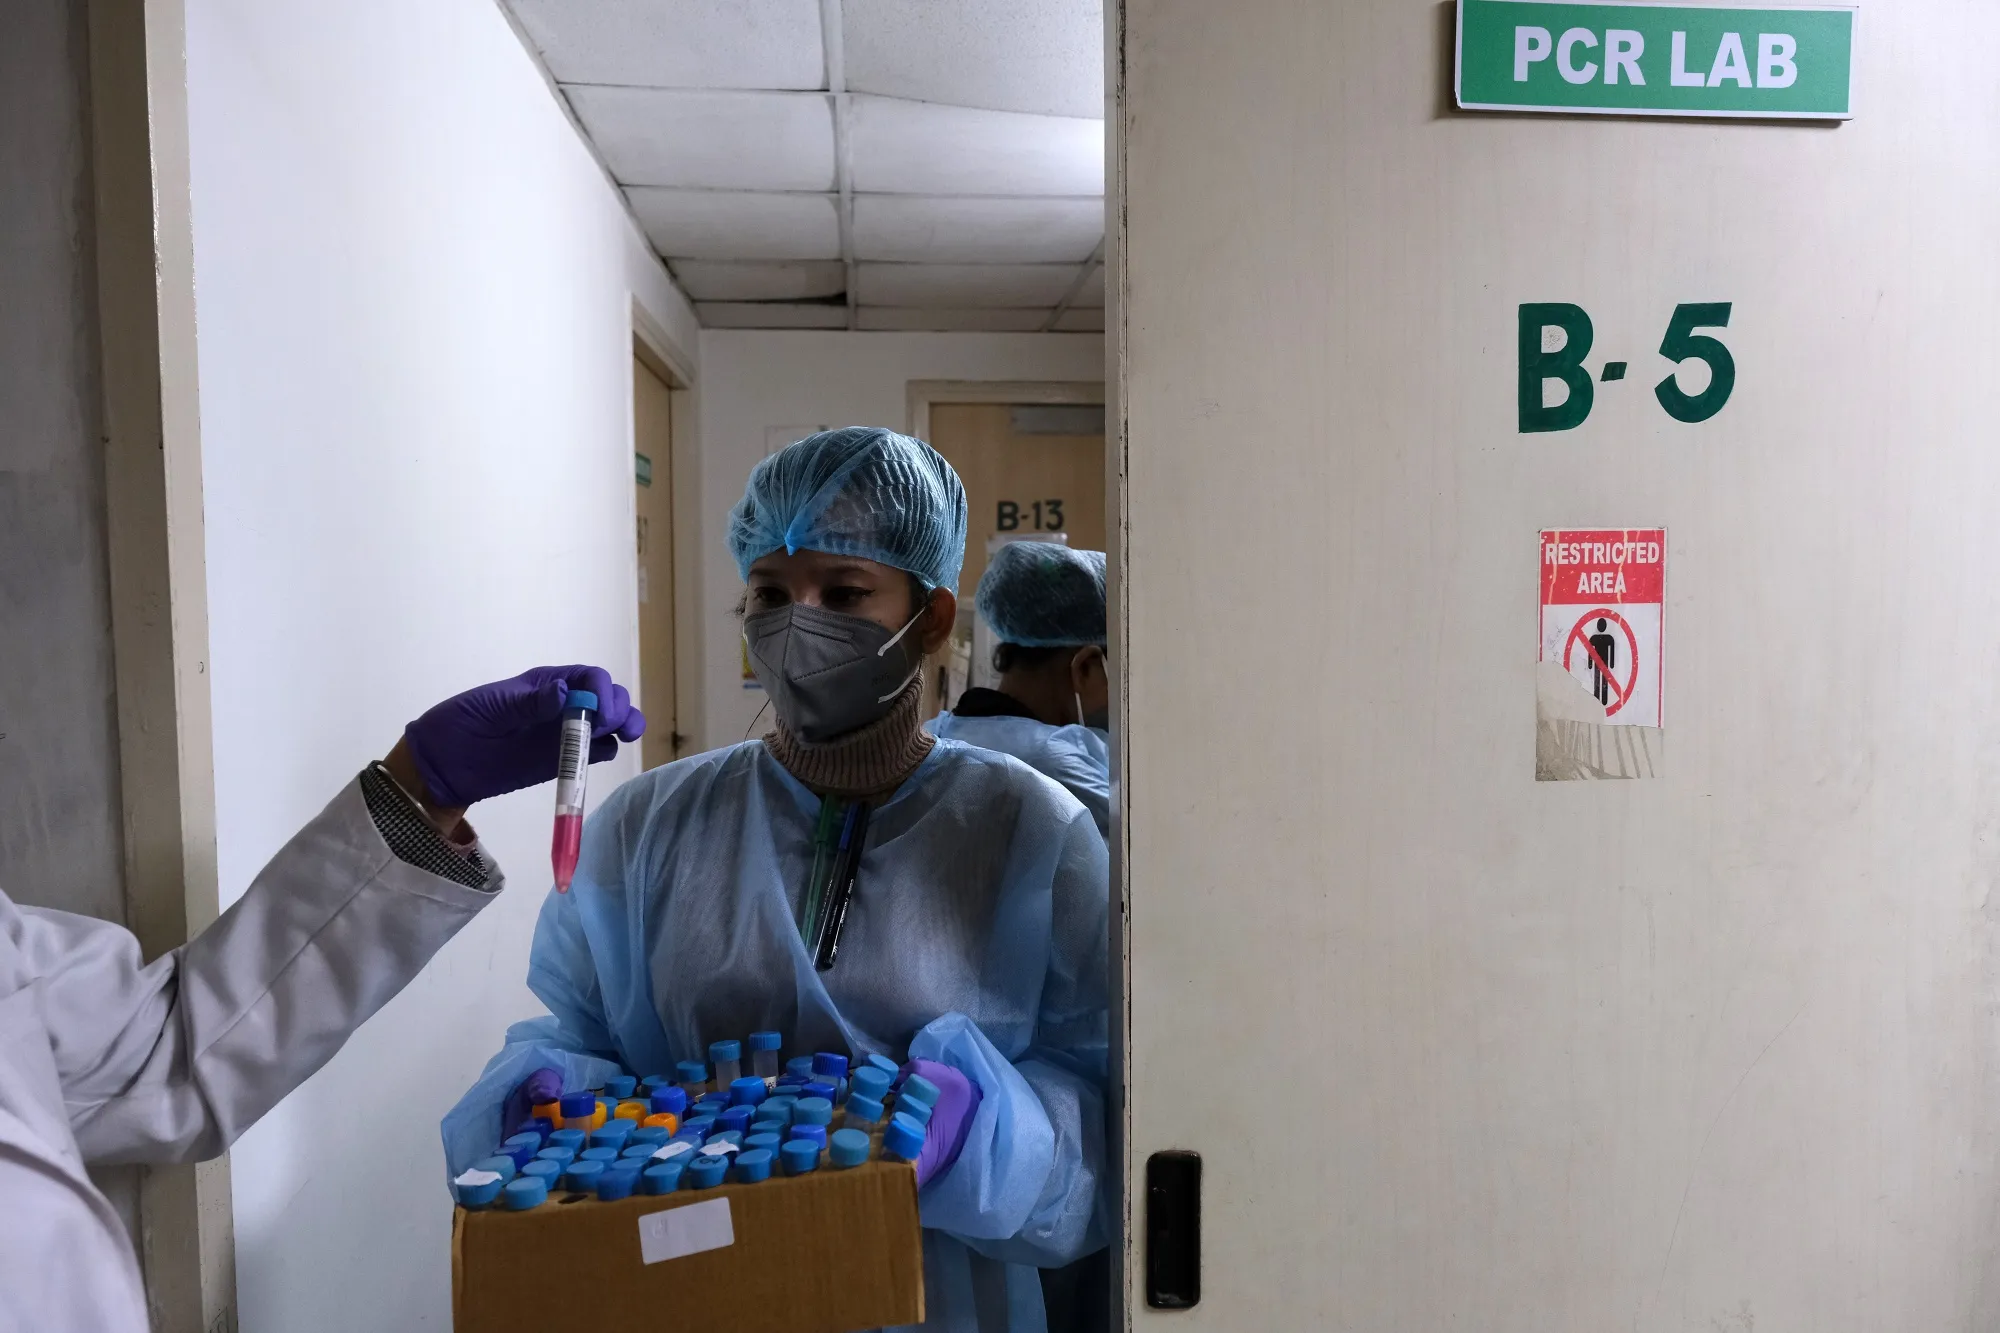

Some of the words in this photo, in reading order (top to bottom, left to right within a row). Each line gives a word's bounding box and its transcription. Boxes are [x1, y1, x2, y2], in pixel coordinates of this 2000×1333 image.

[1513, 25, 1646, 86] PCR
[1669, 30, 1799, 89] LAB
[996, 498, 1065, 532] B-13
[1545, 541, 1660, 565] RESTRICTED
[1577, 571, 1627, 594] AREA
